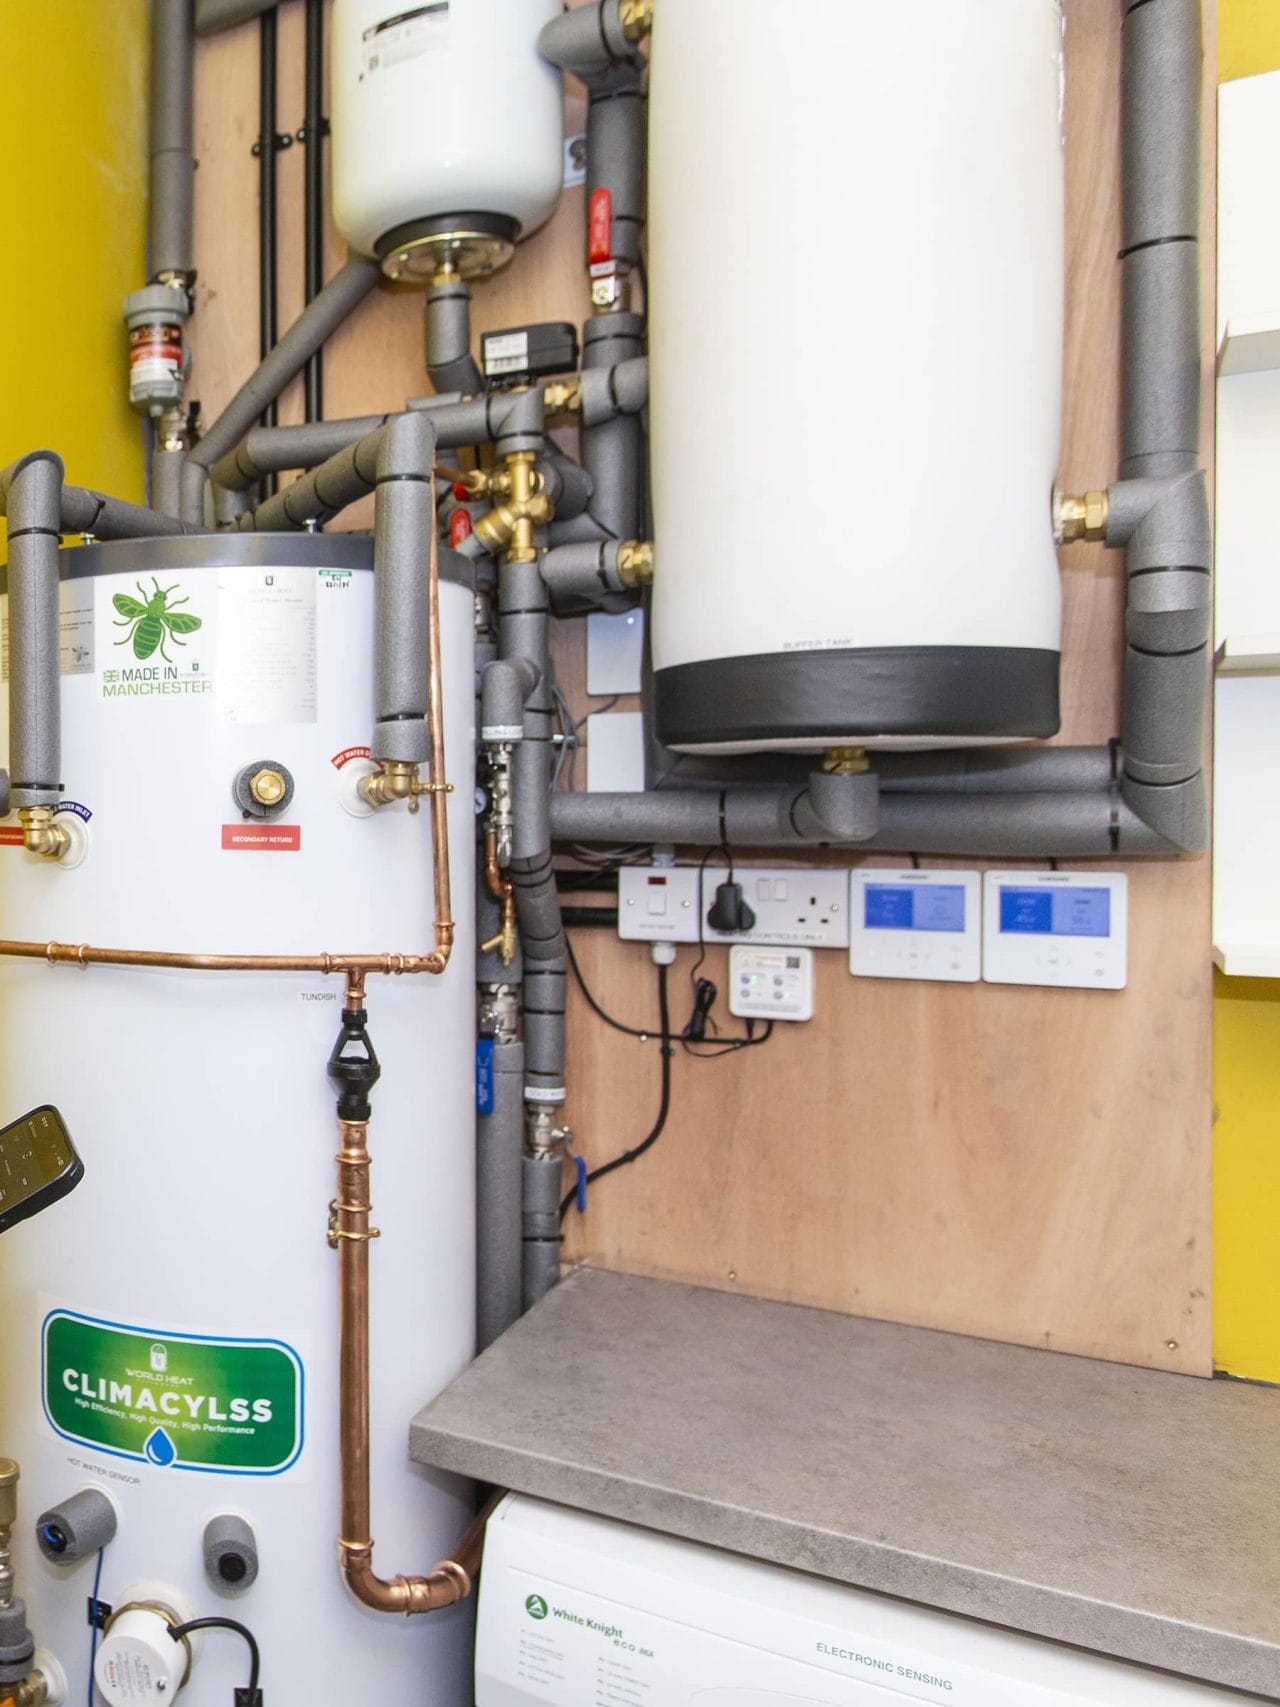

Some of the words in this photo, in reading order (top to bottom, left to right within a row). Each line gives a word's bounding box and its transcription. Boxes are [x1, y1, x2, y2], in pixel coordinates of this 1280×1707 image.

[122, 667, 160, 682] MADE
[163, 667, 178, 680] IN
[103, 681, 212, 697] MANCHESTER
[301, 992, 336, 1001] TUNDISH
[125, 1367, 164, 1382] WORLD
[165, 1375, 194, 1386] HEAT
[62, 1368, 272, 1423] CLIMACYLSS
[75, 1397, 90, 1409] High
[91, 1401, 128, 1420] Efficiency,
[129, 1412, 147, 1423] High
[148, 1415, 180, 1429] Quality,
[182, 1421, 202, 1432] High
[203, 1423, 256, 1435] Performance
[108, 1469, 141, 1485] SENSOR
[552, 1606, 584, 1626] White
[586, 1618, 624, 1638] Knight
[816, 1642, 894, 1673] ELECTRONIC
[896, 1666, 953, 1690] SENSING
